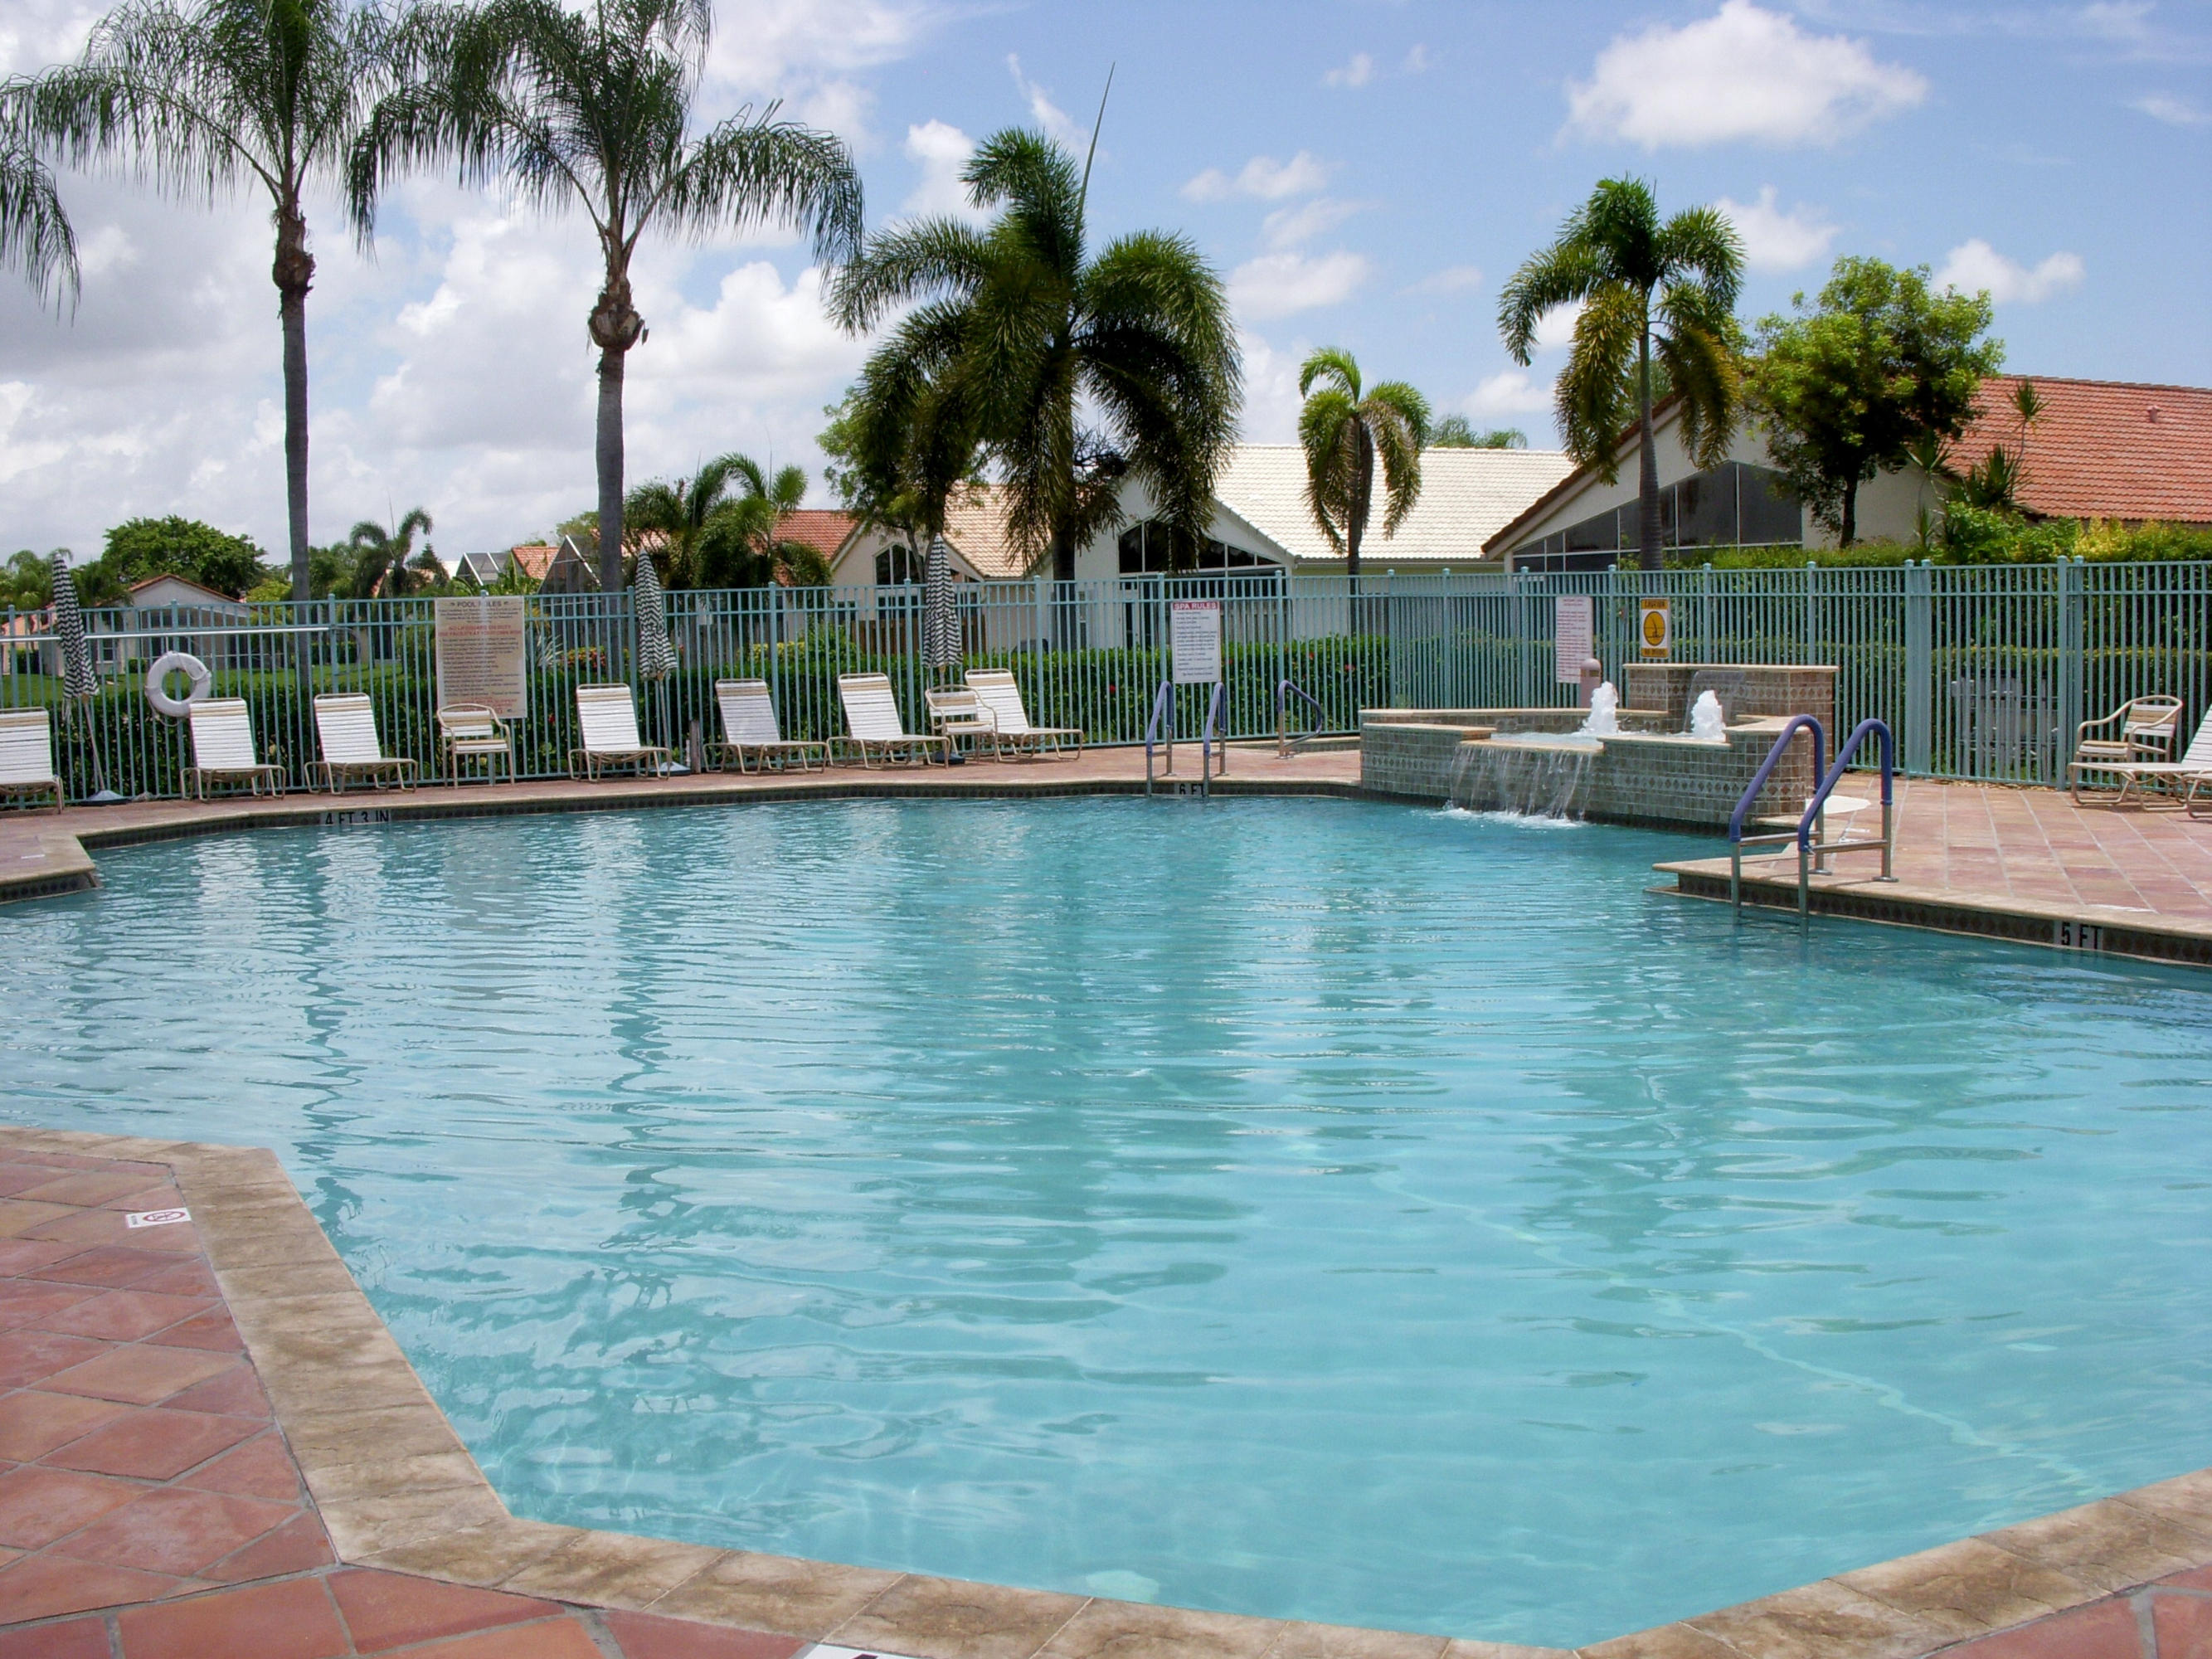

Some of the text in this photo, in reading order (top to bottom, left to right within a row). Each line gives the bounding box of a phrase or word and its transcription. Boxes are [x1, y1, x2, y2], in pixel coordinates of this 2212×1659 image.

[1192, 601, 1217, 610] RULES
[1179, 783, 1204, 795] 6 FT
[325, 813, 333, 825] 4
[338, 812, 355, 824] FT
[376, 810, 389, 822] IN
[2061, 922, 2103, 949] 5 FT
